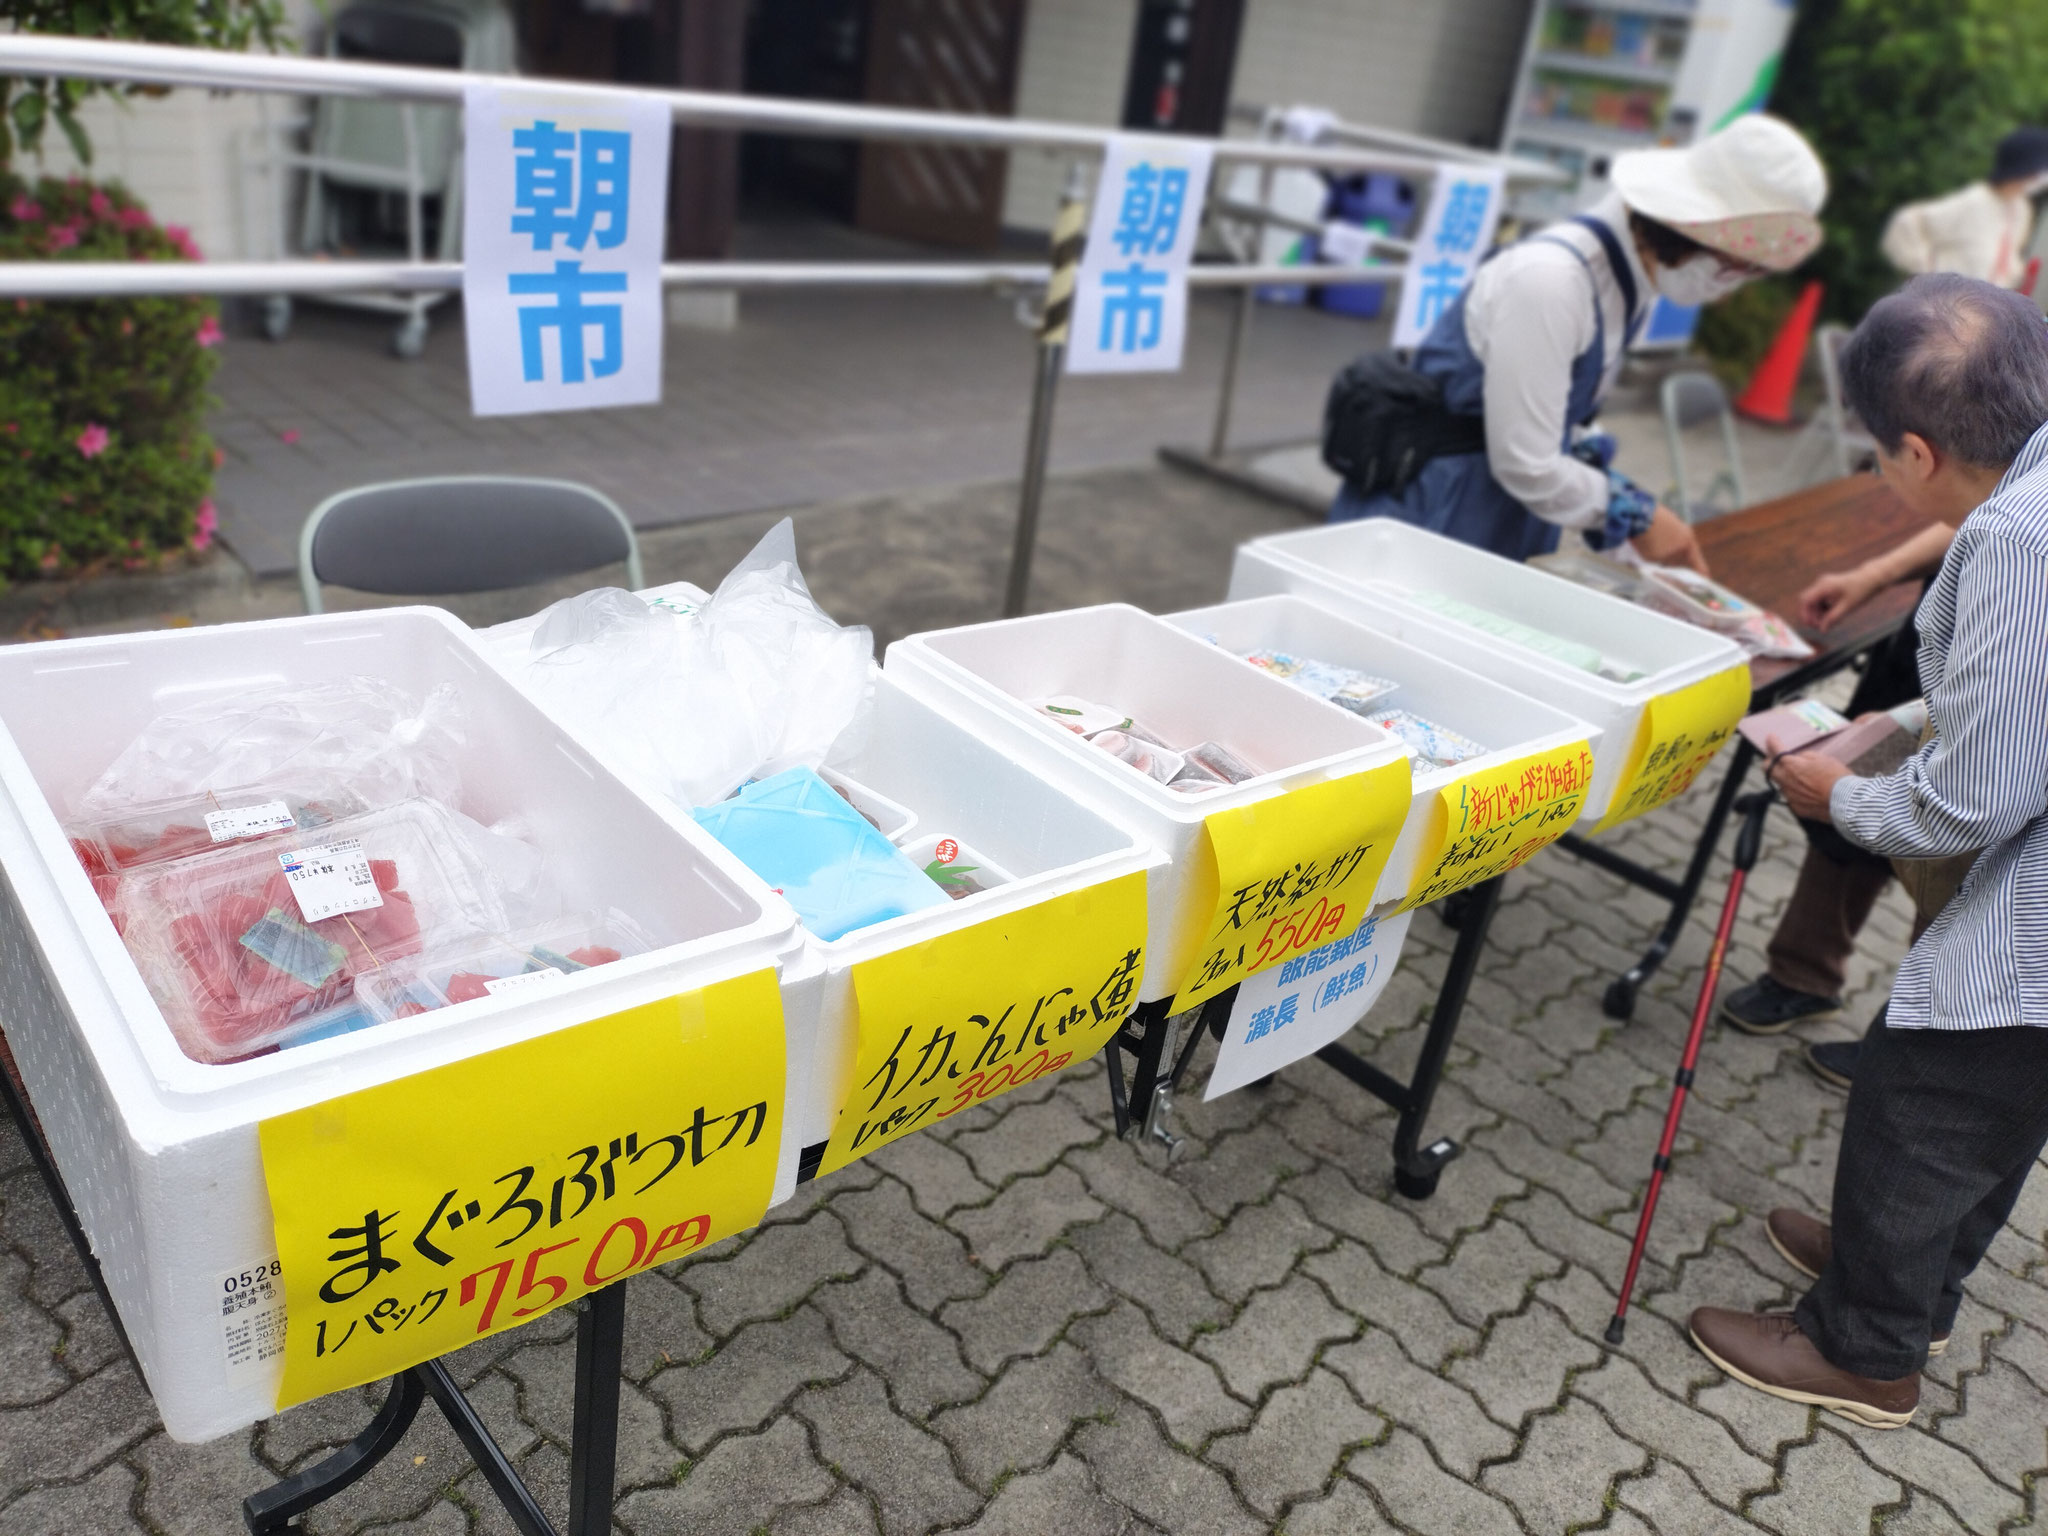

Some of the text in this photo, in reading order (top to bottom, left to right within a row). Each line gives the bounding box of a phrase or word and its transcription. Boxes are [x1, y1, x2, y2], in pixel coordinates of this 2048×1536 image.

[507, 120, 632, 384] 朝市
[1098, 162, 1189, 354] 朝市
[1415, 180, 1491, 330] 朝市
[1211, 843, 1374, 943] 天然紅サケ
[1247, 896, 1346, 973] 550円
[862, 947, 1142, 1114] イカこんにゃく煮
[936, 1048, 1074, 1118] 300円
[318, 1100, 767, 1304] まぐろぶつ切
[223, 1260, 282, 1293] 0528
[315, 1213, 712, 1358] 1パック 750円
